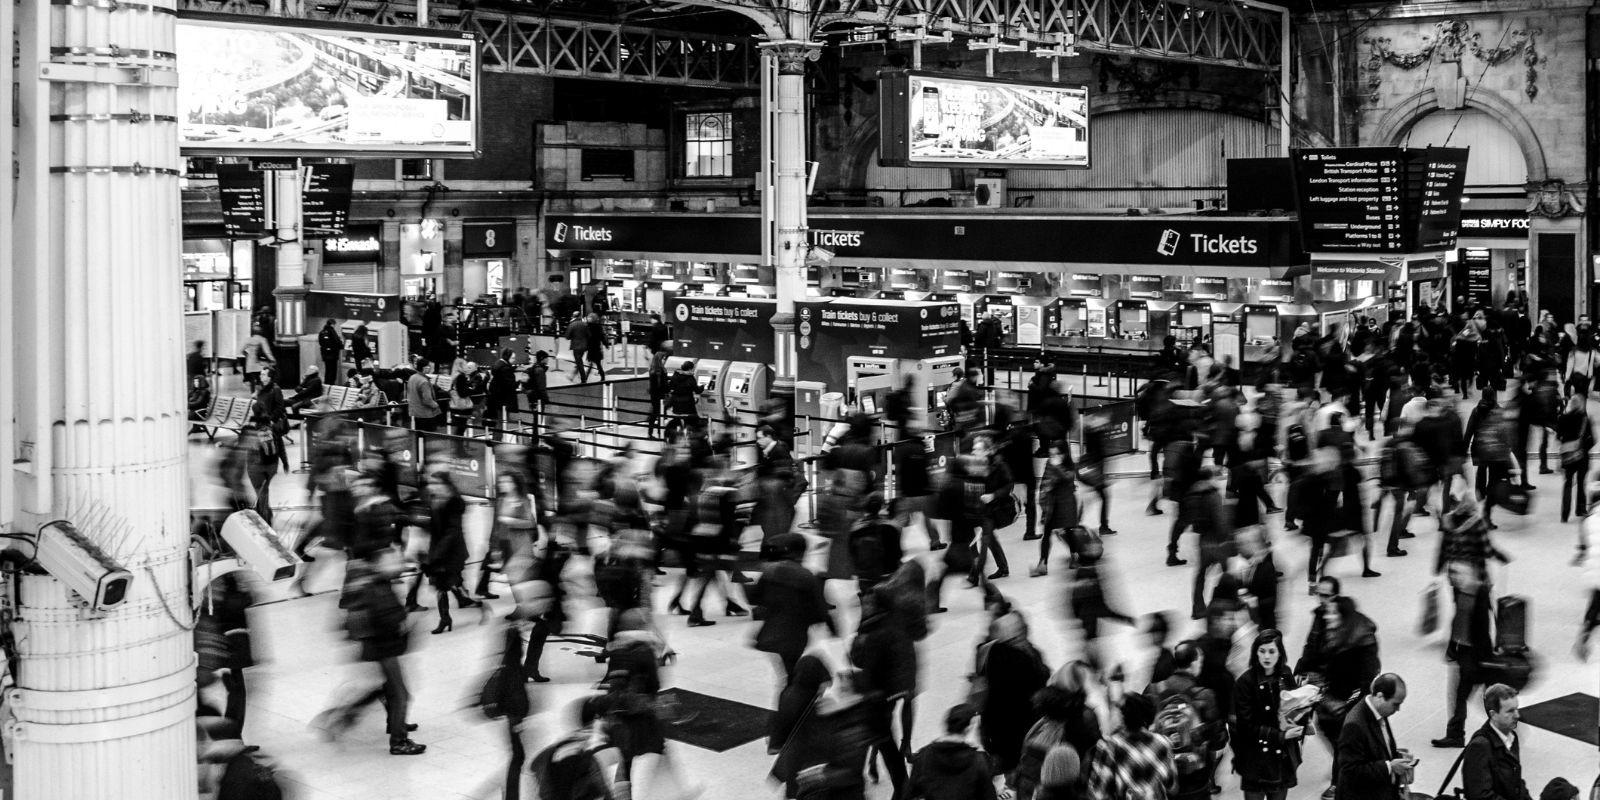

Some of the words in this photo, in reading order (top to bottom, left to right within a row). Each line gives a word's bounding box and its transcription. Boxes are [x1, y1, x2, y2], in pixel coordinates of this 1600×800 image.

[1481, 219, 1511, 228] SIMPLY
[572, 225, 613, 241] Tickets
[338, 237, 380, 251] iSmash
[1190, 233, 1258, 254] Tickets
[691, 305, 704, 314] Train
[704, 306, 723, 316] tickets
[724, 307, 734, 317] buy
[735, 308, 740, 316] &
[740, 308, 758, 317] collect
[821, 309, 836, 319] Train
[837, 310, 858, 320] tickets
[859, 311, 871, 323] buy
[871, 312, 877, 321] &
[878, 312, 899, 322] collect
